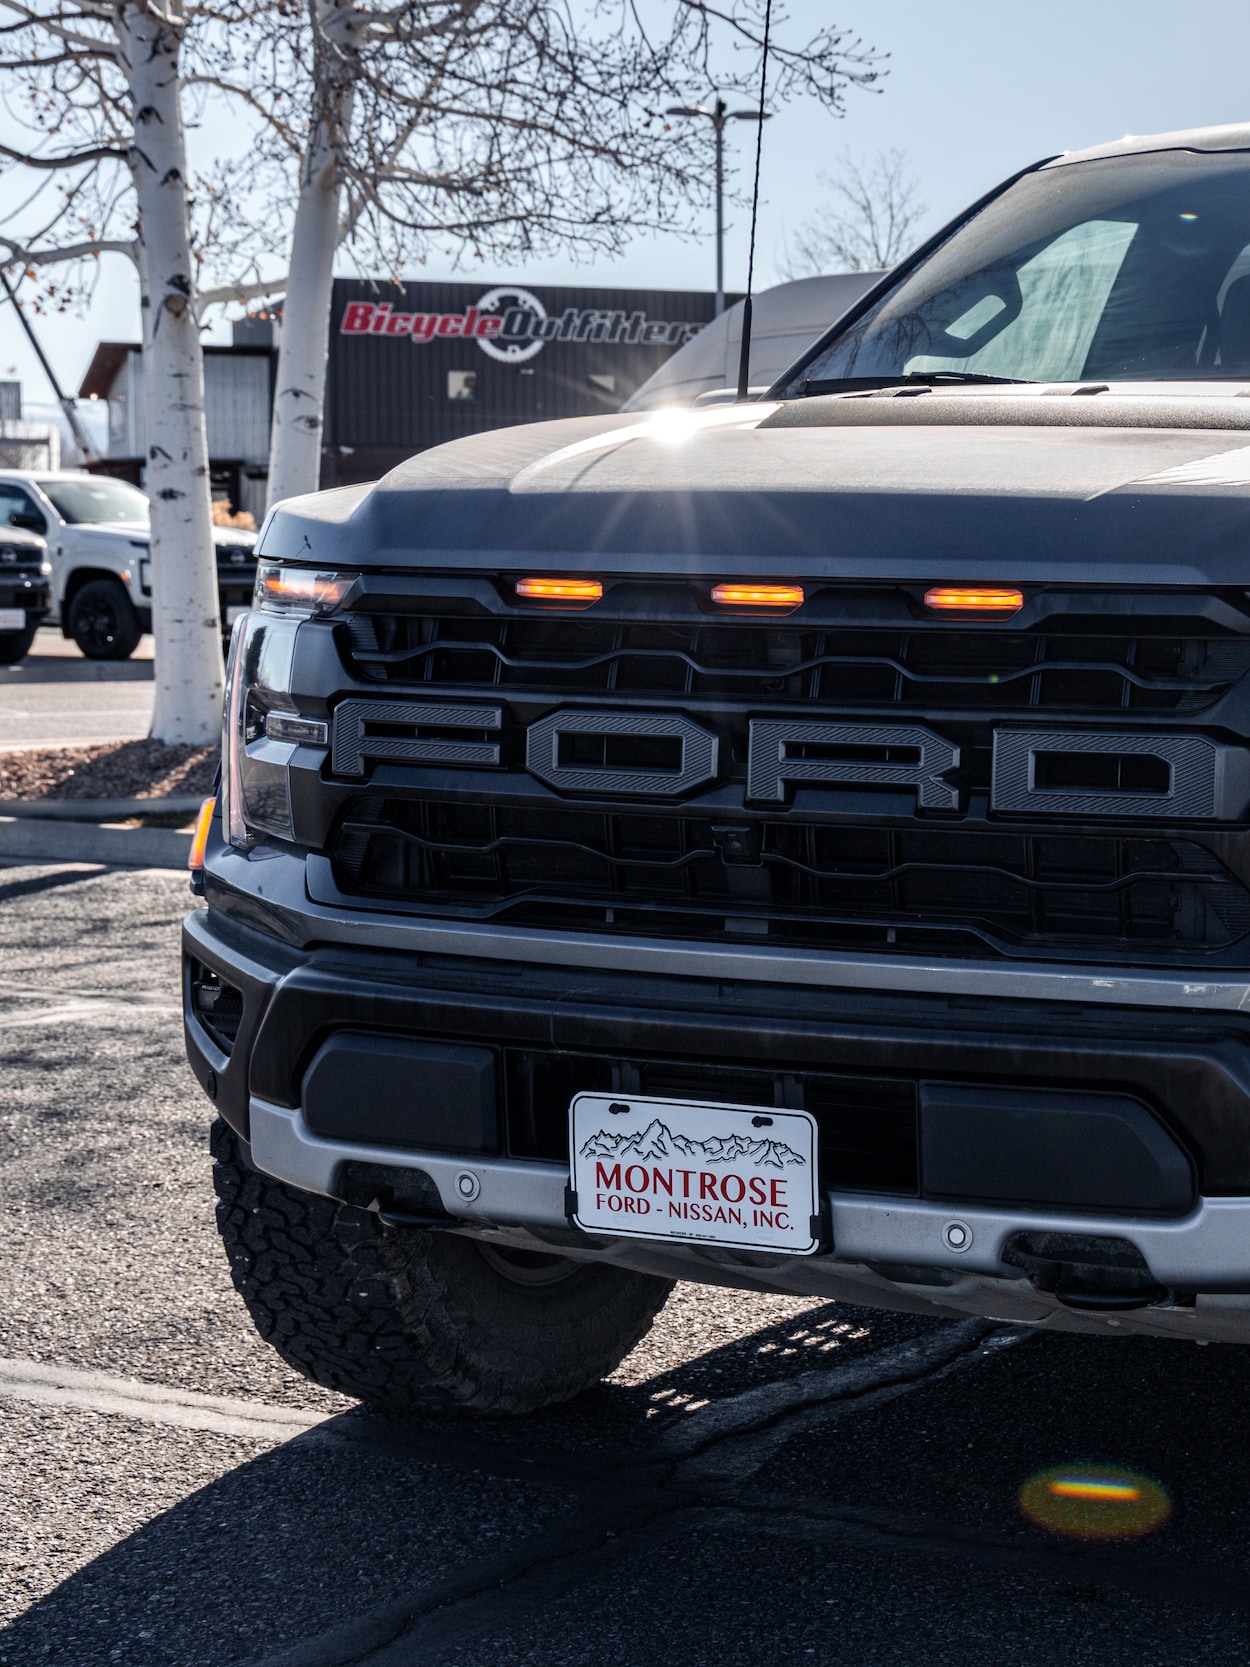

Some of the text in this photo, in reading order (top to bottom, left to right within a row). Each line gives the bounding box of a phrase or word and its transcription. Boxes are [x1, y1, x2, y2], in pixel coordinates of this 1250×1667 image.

[341, 301, 502, 343] Bicycle
[331, 698, 1217, 818] FORD
[595, 1161, 788, 1208] MONTROSE
[596, 1193, 650, 1214] FORD
[668, 1201, 748, 1228] NISSAN,
[753, 1210, 794, 1230] INC.
